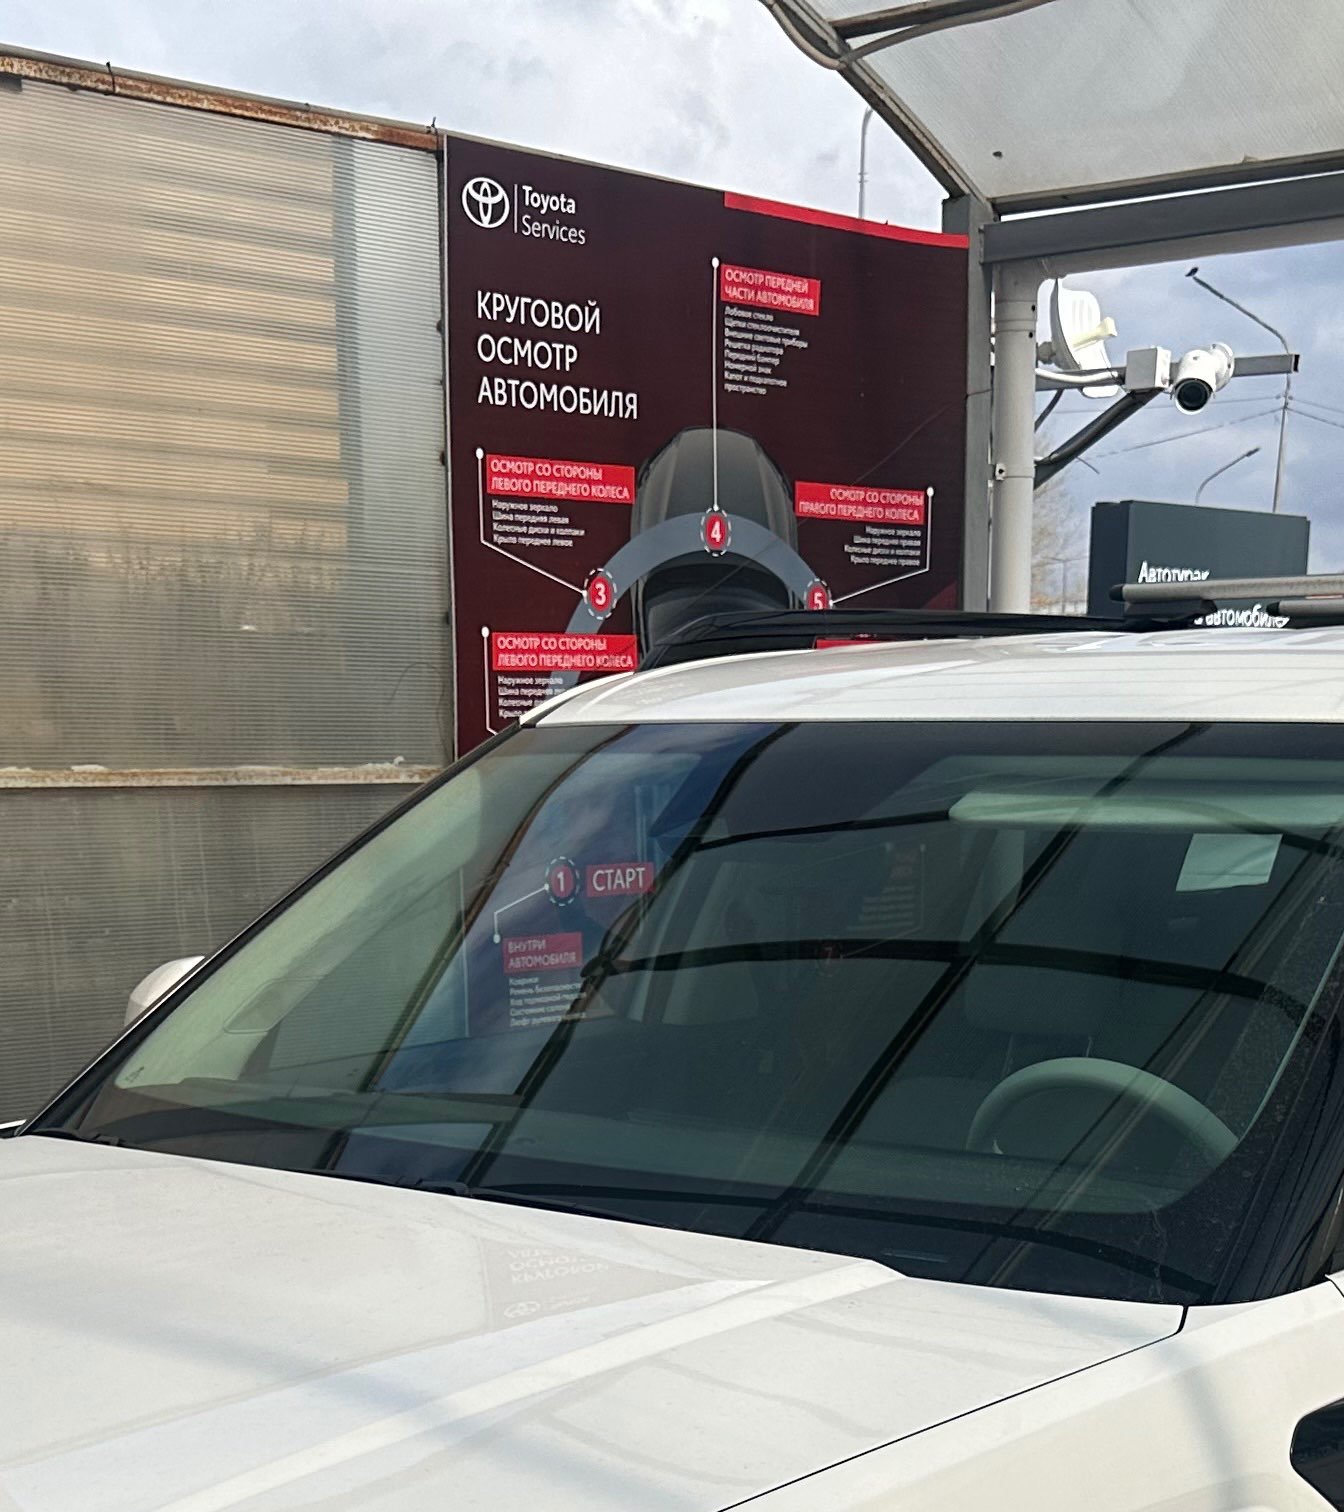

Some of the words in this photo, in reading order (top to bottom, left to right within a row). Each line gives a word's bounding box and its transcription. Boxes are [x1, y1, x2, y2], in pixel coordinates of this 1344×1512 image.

[522, 186, 576, 214] Toyota
[521, 213, 586, 245] Services
[725, 269, 764, 285] ОСМОТР
[765, 276, 809, 294] ПЕРЕДНЕЙ
[725, 285, 755, 301] ЧАСТИ
[756, 290, 814, 311] АВТОМОБИЛЯ
[477, 289, 600, 335] КРУГОВОЙ
[477, 335, 578, 372] ОСМОТР
[477, 376, 639, 420] АВТОМОБИЛЯ
[491, 459, 534, 475] ОСМОТР
[536, 463, 551, 476] СО
[553, 465, 603, 481] СТОРОНЫ
[491, 477, 531, 492] ЛЕВОГО
[533, 480, 590, 496] ПЕРЕДНЕГО
[591, 485, 630, 499] КОЛЕСА
[830, 488, 864, 502] ОСМОТР
[866, 492, 879, 503] СО
[880, 493, 924, 506] СТОРОНЫ
[799, 501, 836, 515] ПРАВОГО
[837, 504, 884, 518] ПЕРЕДНЕГО
[885, 508, 919, 521] КОЛЕСА
[710, 521, 722, 542] 4
[594, 583, 607, 604] 3
[813, 593, 824, 611] 5
[497, 637, 540, 650] ОСМОТР
[541, 637, 557, 650] СО
[558, 638, 607, 651] СТОРОНЫ
[497, 653, 538, 667] ЛЕВОГО
[539, 654, 594, 669] ПЕРЕДНЕГО
[596, 655, 633, 668] КОЛЕСА
[556, 872, 565, 892] 1
[592, 866, 646, 892] СТАРТ
[508, 939, 546, 954] ВНУТРИ
[508, 951, 577, 969] АВТОМОБИЛЯ
